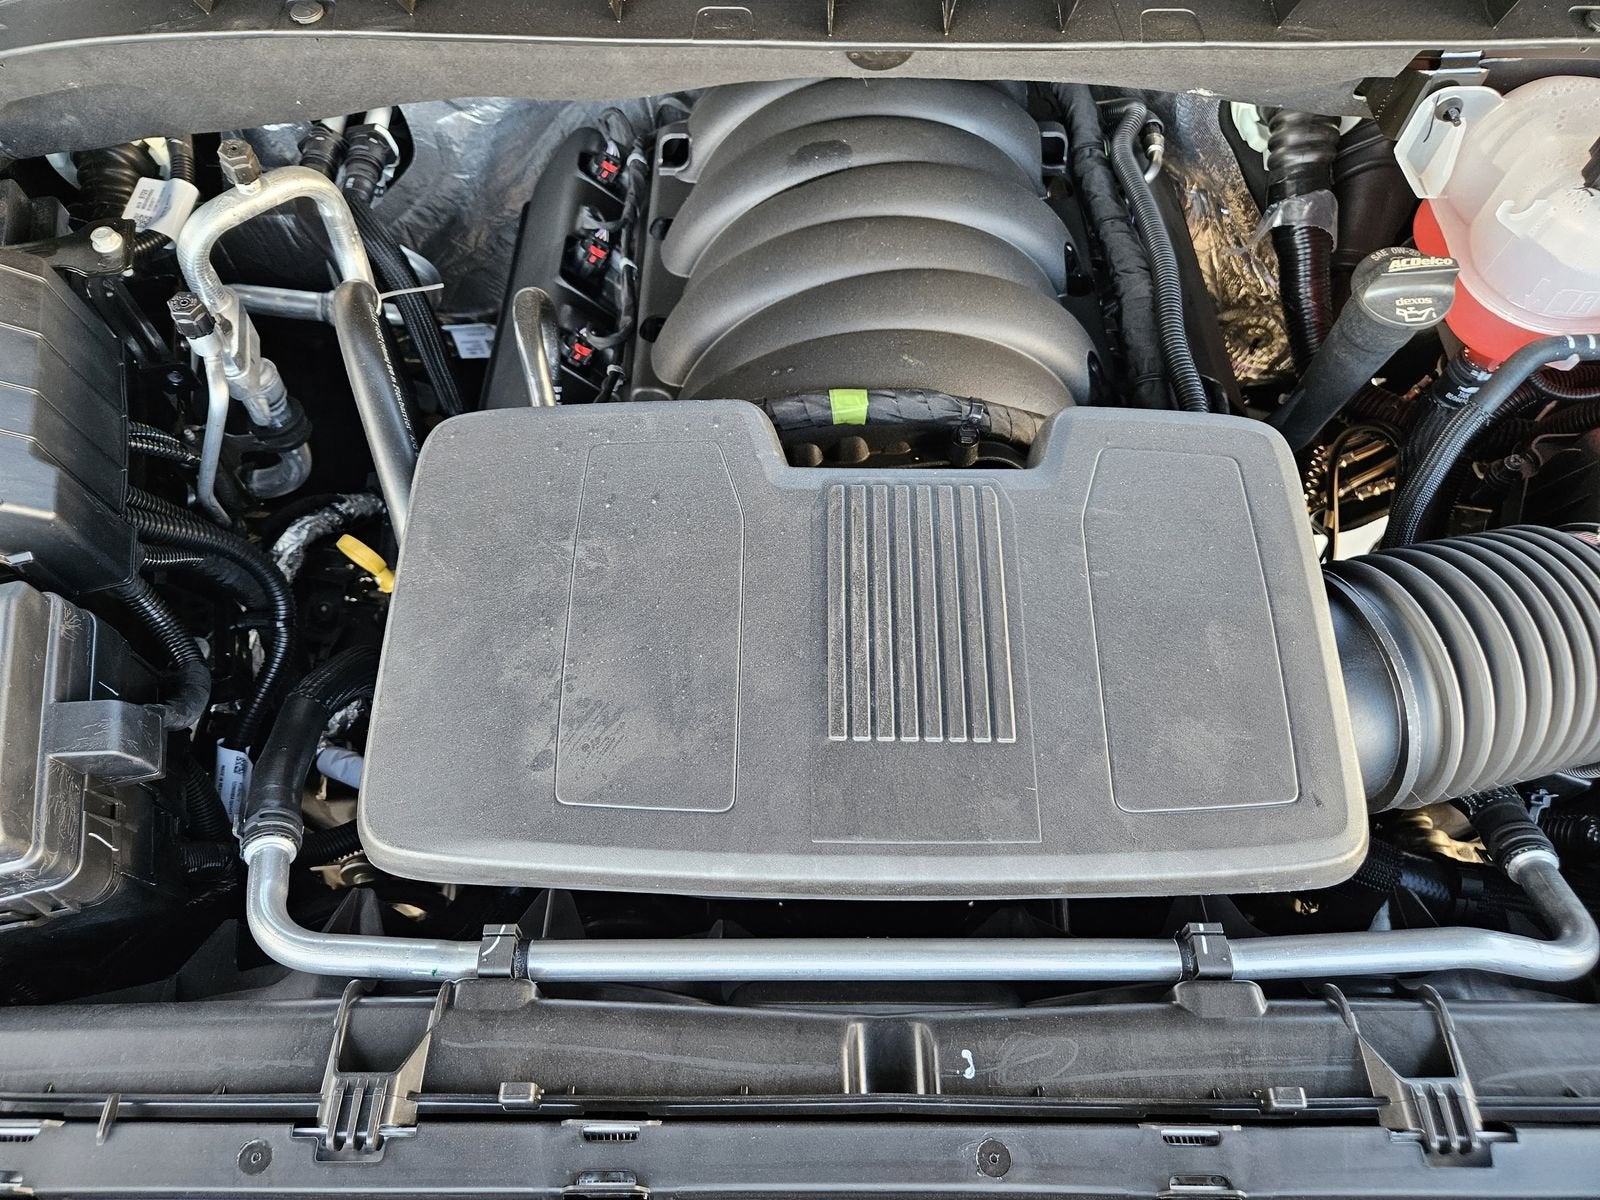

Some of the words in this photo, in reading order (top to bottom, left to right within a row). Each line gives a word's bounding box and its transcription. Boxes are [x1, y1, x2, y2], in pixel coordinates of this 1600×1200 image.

[1370, 249, 1389, 261] SAE
[1390, 247, 1421, 257] 0W-20
[1389, 257, 1454, 270] ACDelco
[1395, 297, 1433, 306] dexos
